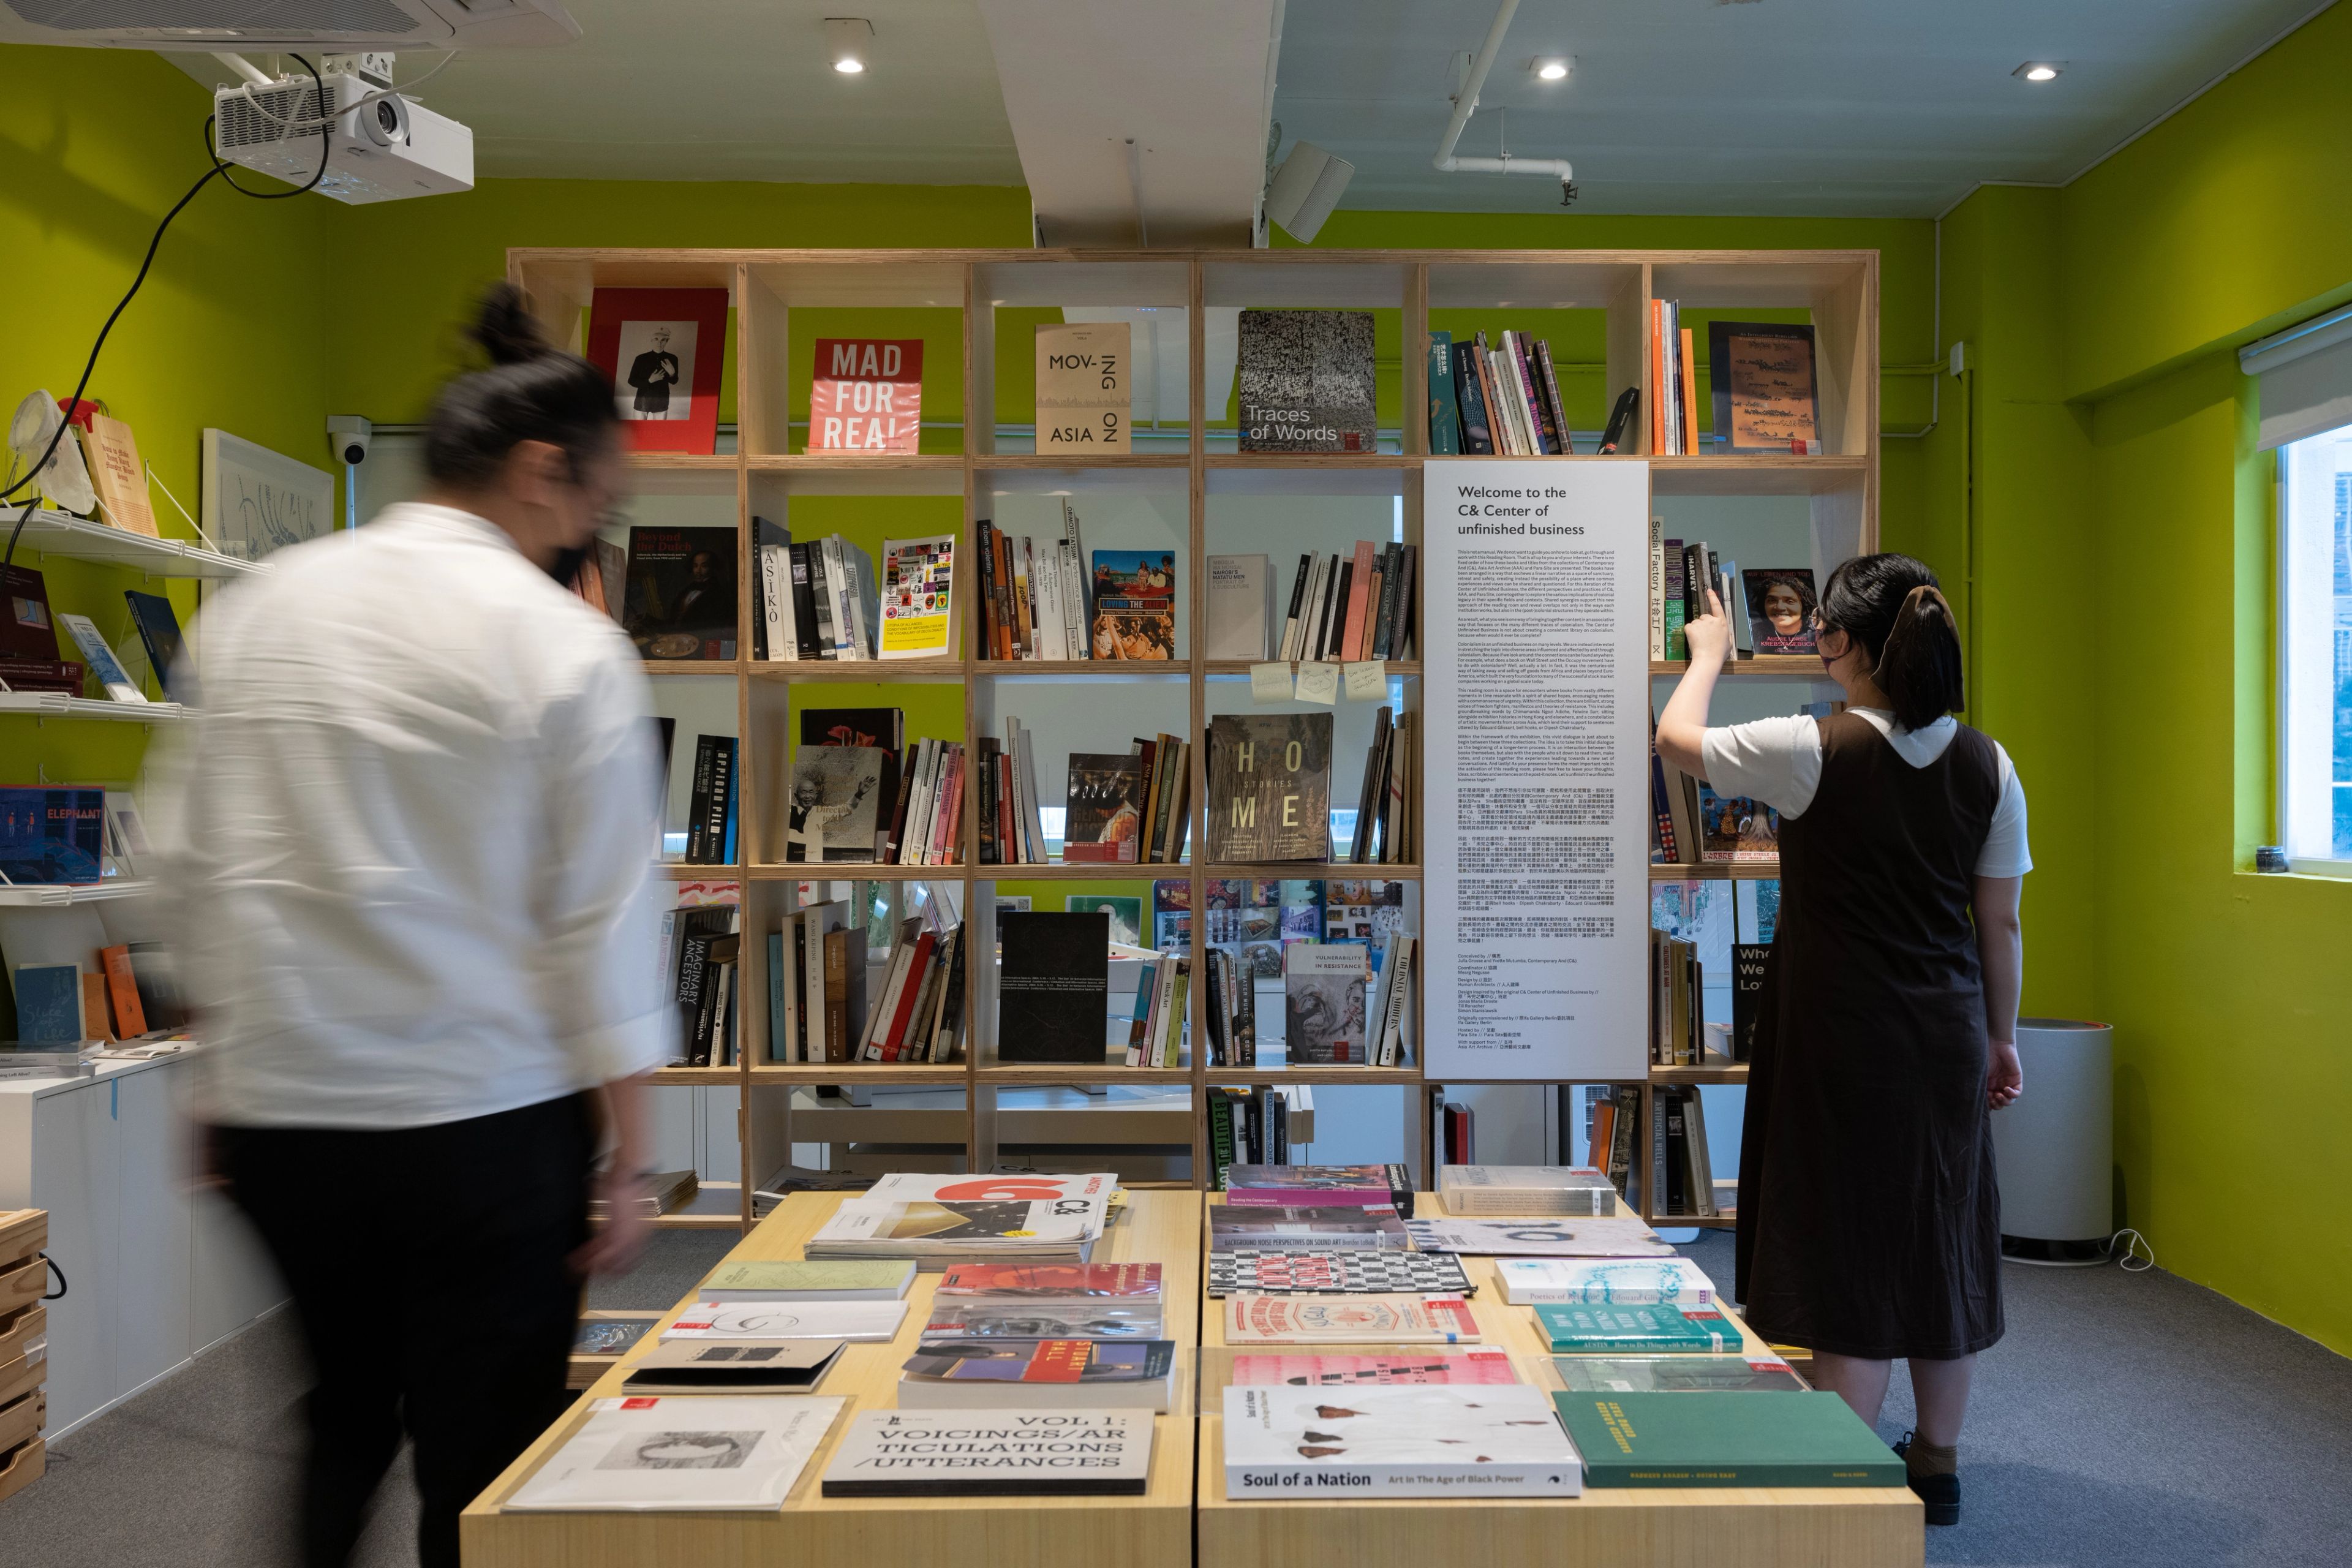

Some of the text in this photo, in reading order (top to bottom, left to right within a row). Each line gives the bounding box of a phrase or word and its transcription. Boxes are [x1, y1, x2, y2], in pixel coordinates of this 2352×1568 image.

[832, 344, 901, 376] MAD
[1050, 355, 1115, 390] MOV- ING
[835, 381, 894, 413] FOR
[1246, 405, 1310, 421] Traces
[1529, 402, 1544, 437] MINBAK
[1050, 413, 1117, 442] ASIA ON
[1251, 424, 1337, 440] of Words
[1458, 486, 1566, 498] Welcome to the
[1458, 505, 1548, 516] C& Center of
[638, 533, 681, 541] Beyond
[1458, 523, 1584, 535] unfinished business
[637, 542, 692, 551] the Dutch
[846, 567, 858, 598] COMPARISON
[1652, 553, 1660, 591] Factory
[1665, 546, 1683, 598] DIVIDED WE STAND
[1398, 585, 1407, 637] INTERSECTIONALITY
[1144, 763, 1152, 778] ASIA
[941, 779, 952, 815] UNDERGROUND
[1158, 780, 1171, 832] Provincializing Europe
[48, 809, 101, 819] ELEPHANT
[892, 924, 903, 948] LAWRENCE
[679, 939, 693, 1003] ANCESTORS
[688, 941, 705, 1005] IMAGINARY
[1390, 957, 1408, 1030] COLONIAL MODERN
[1654, 1101, 1662, 1140] ARTIFICIAL
[1654, 1140, 1663, 1165] HELLS
[1083, 1177, 1104, 1195] ANOTHER
[1053, 1199, 1091, 1216] C&
[1046, 1341, 1064, 1361] HALL
[1068, 1341, 1093, 1371] STUART
[1016, 1417, 1126, 1425] VOL 1:
[876, 1430, 1126, 1439] VOICINGS/AR
[876, 1443, 1123, 1453] TICULATIONS
[854, 1457, 1120, 1467] /UTTERANCES
[1243, 1473, 1279, 1487] Soul
[1283, 1472, 1300, 1487] of
[1303, 1477, 1314, 1486] a
[1317, 1473, 1371, 1487] Nation
[1406, 1476, 1415, 1484] In
[1416, 1476, 1435, 1484] The
[1436, 1476, 1455, 1486] Age
[1468, 1475, 1493, 1484] Black
[1494, 1475, 1525, 1484] Power
